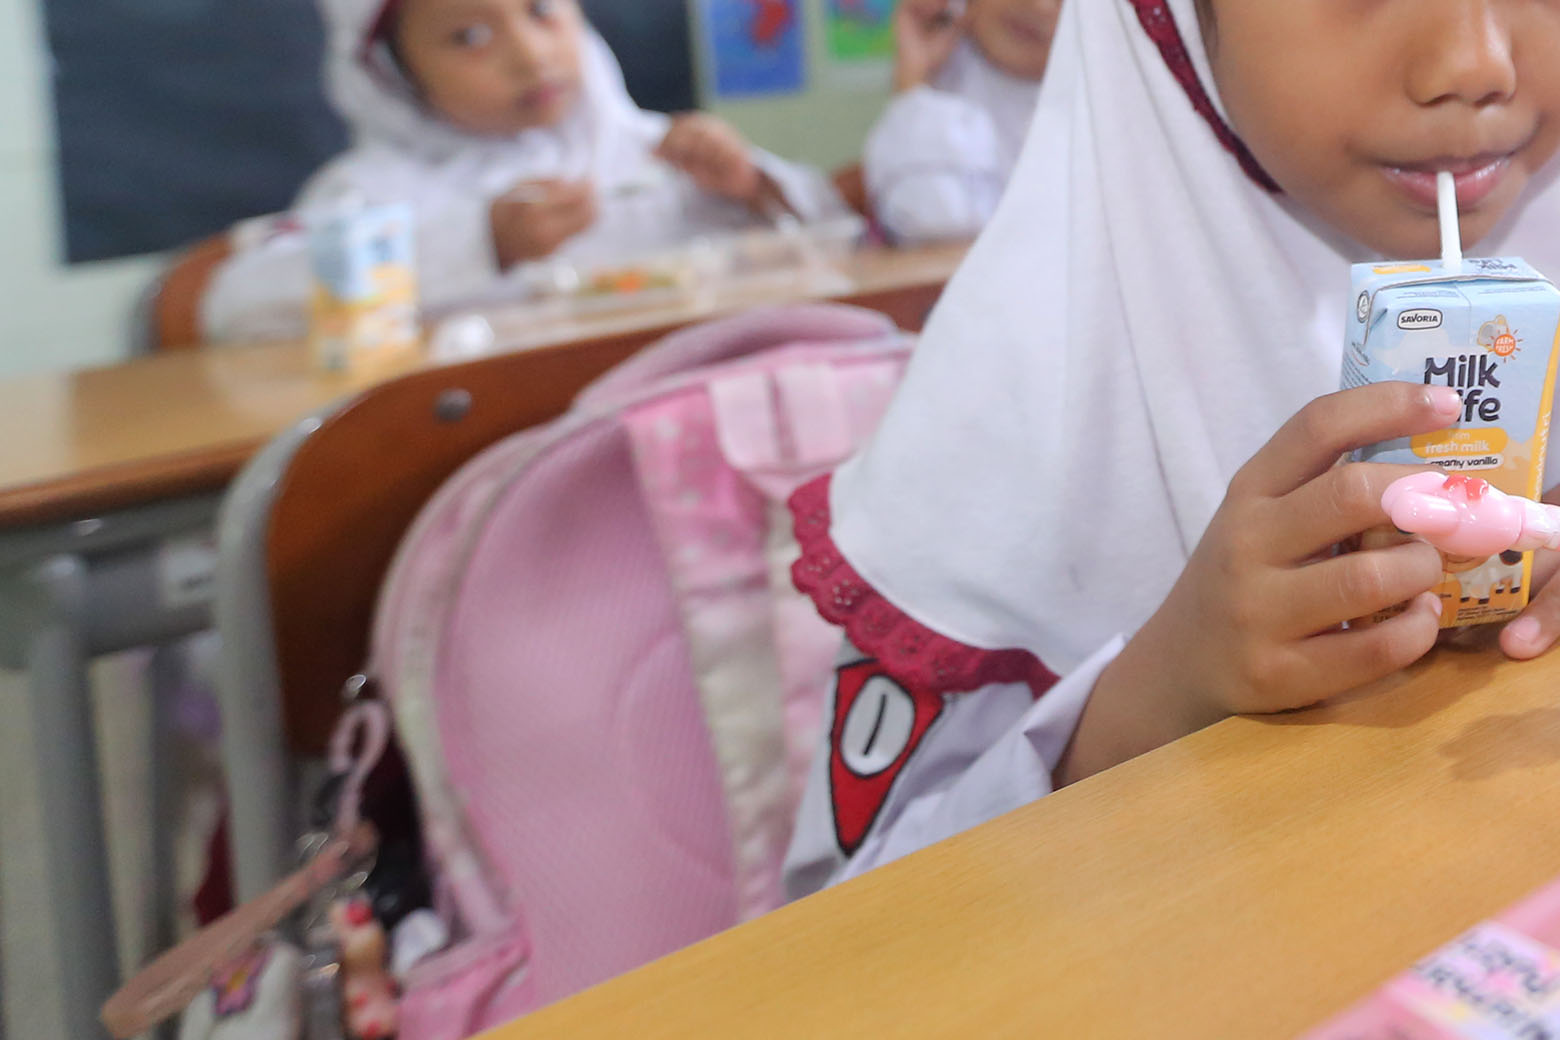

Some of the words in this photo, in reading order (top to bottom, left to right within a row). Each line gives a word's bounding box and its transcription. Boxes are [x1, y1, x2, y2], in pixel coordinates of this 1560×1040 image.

[1401, 314, 1438, 324] SAVORIA
[1424, 354, 1501, 388] Milk
[1425, 441, 1458, 455] fresh
[1461, 439, 1490, 452] milk
[1467, 456, 1498, 466] vanilla
